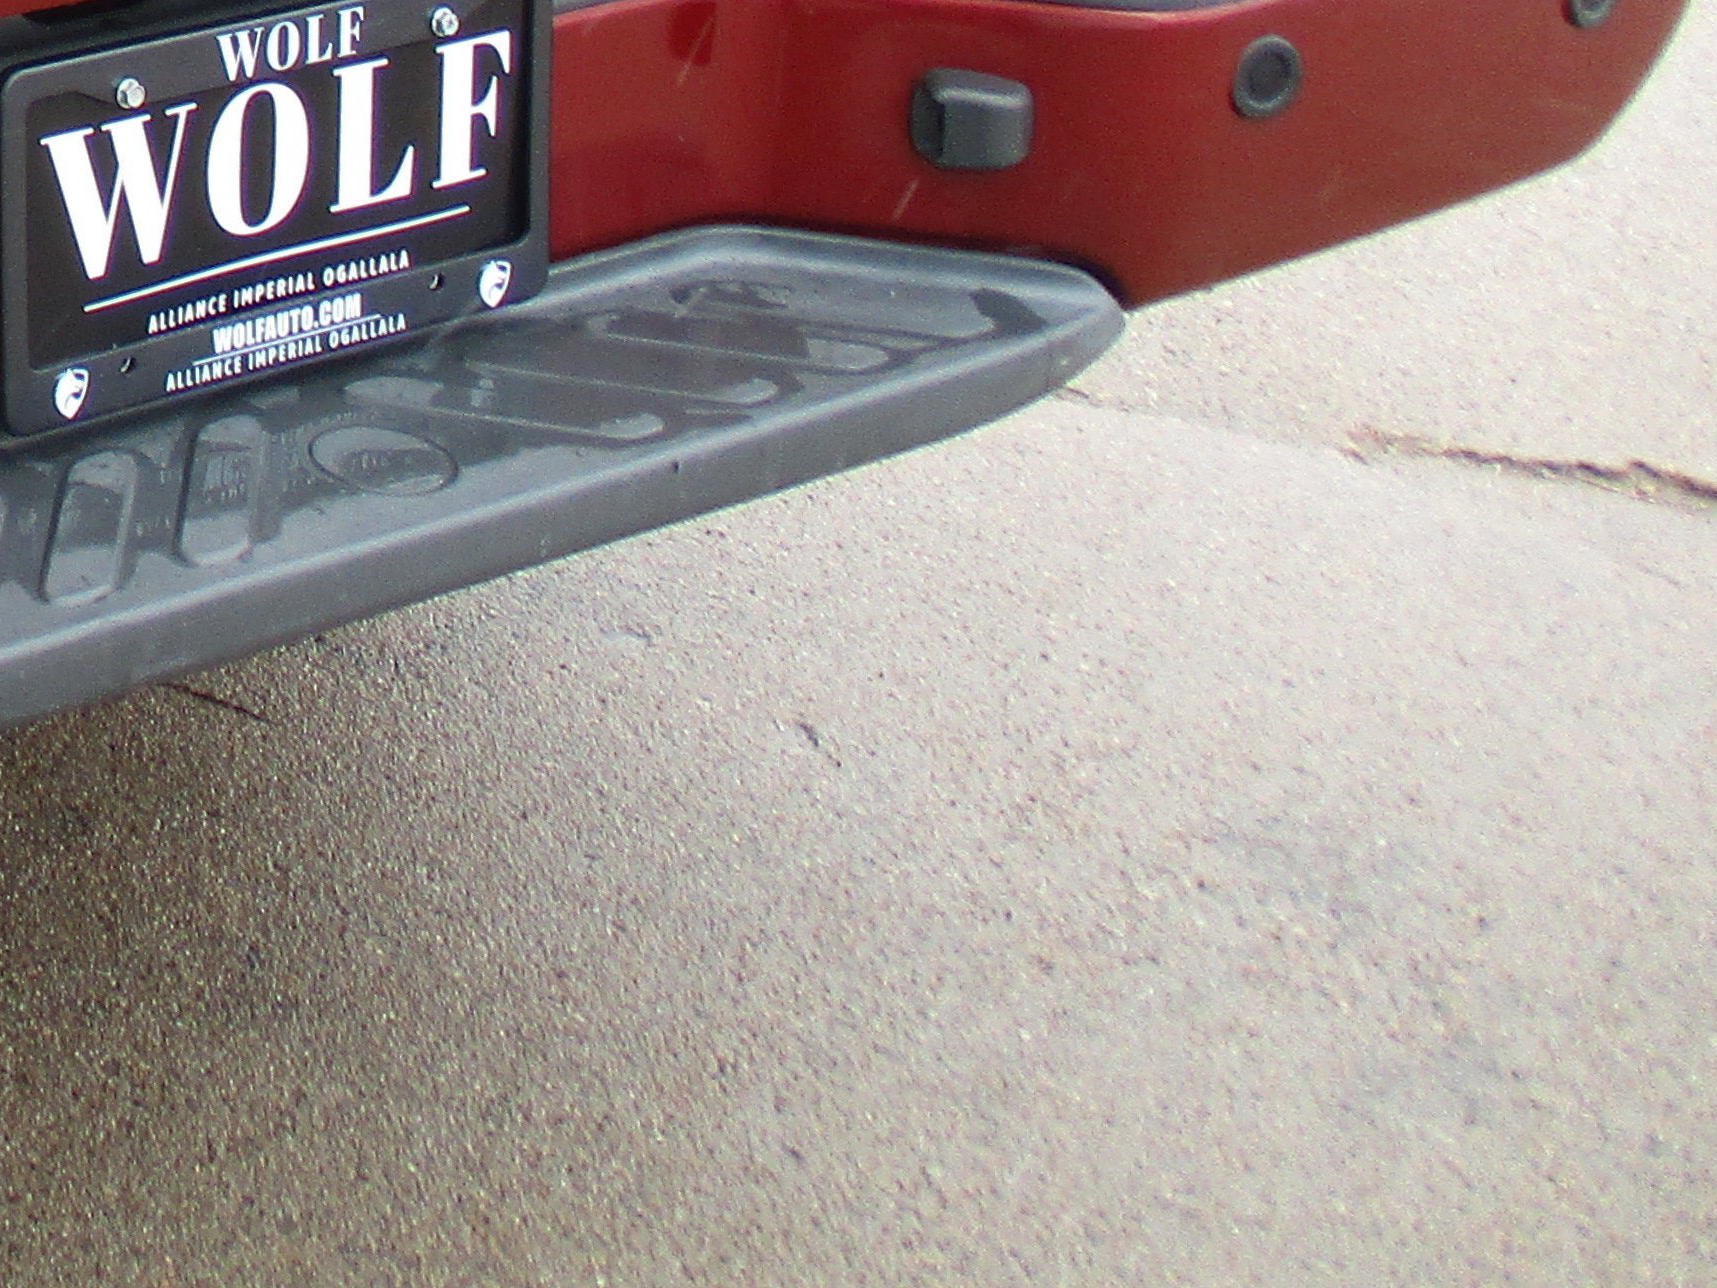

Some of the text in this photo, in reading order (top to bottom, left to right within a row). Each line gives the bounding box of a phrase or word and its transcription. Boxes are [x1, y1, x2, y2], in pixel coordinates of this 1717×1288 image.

[216, 6, 365, 82] WOLF
[39, 29, 513, 281] WOLF
[147, 249, 410, 335] ALLIANCE IMPERIAL OGALLALA
[212, 292, 362, 355] WOLFAUTO.COM
[165, 313, 407, 392] ALLIANCE IMPERIAL OGALLALA
